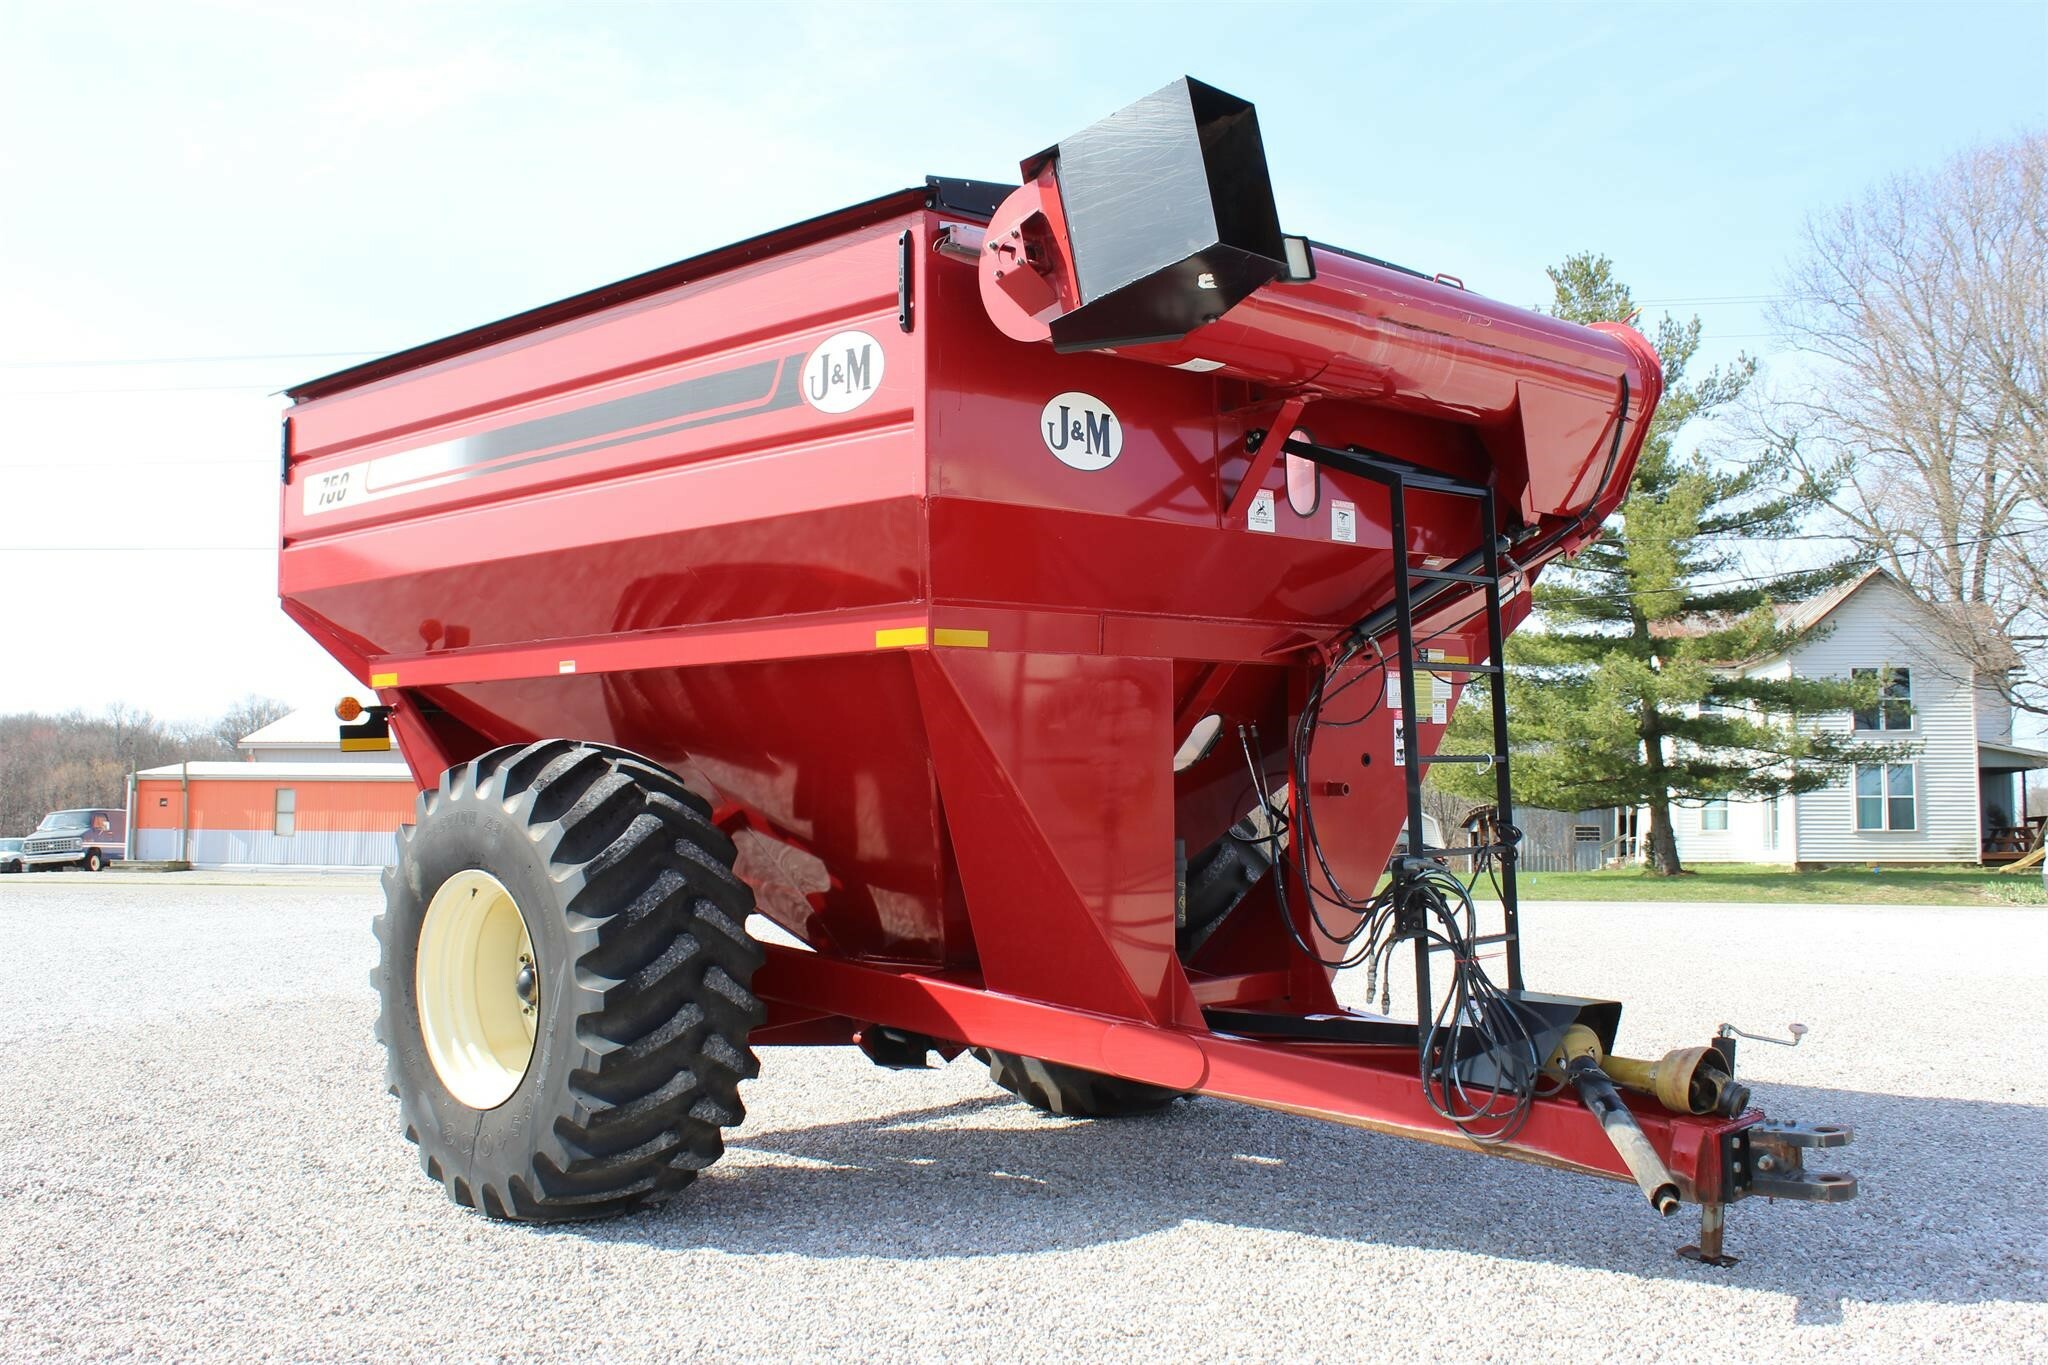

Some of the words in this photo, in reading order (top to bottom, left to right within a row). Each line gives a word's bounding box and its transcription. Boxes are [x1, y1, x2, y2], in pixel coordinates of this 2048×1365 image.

[810, 344, 871, 401] J&M
[1047, 405, 1111, 458] J&M
[319, 472, 350, 506] 750
